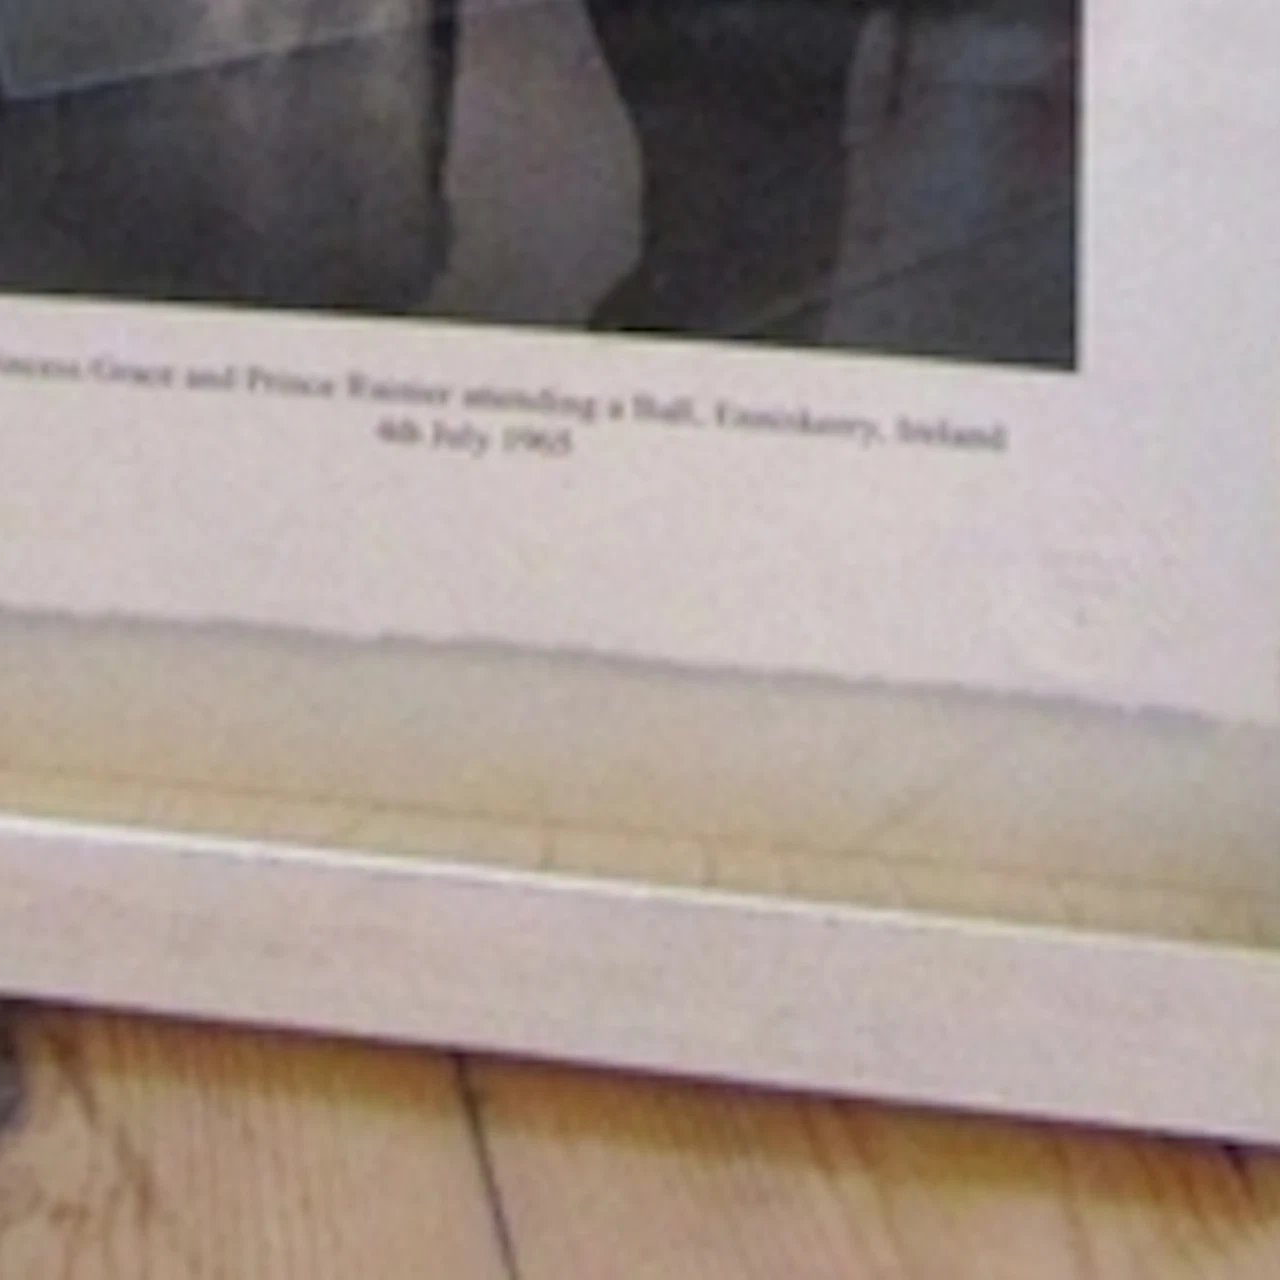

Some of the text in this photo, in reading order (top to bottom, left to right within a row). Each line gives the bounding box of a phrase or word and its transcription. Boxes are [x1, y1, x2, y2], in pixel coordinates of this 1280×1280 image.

[184, 363, 236, 392] and
[246, 365, 335, 398] Prince
[606, 399, 624, 421] a
